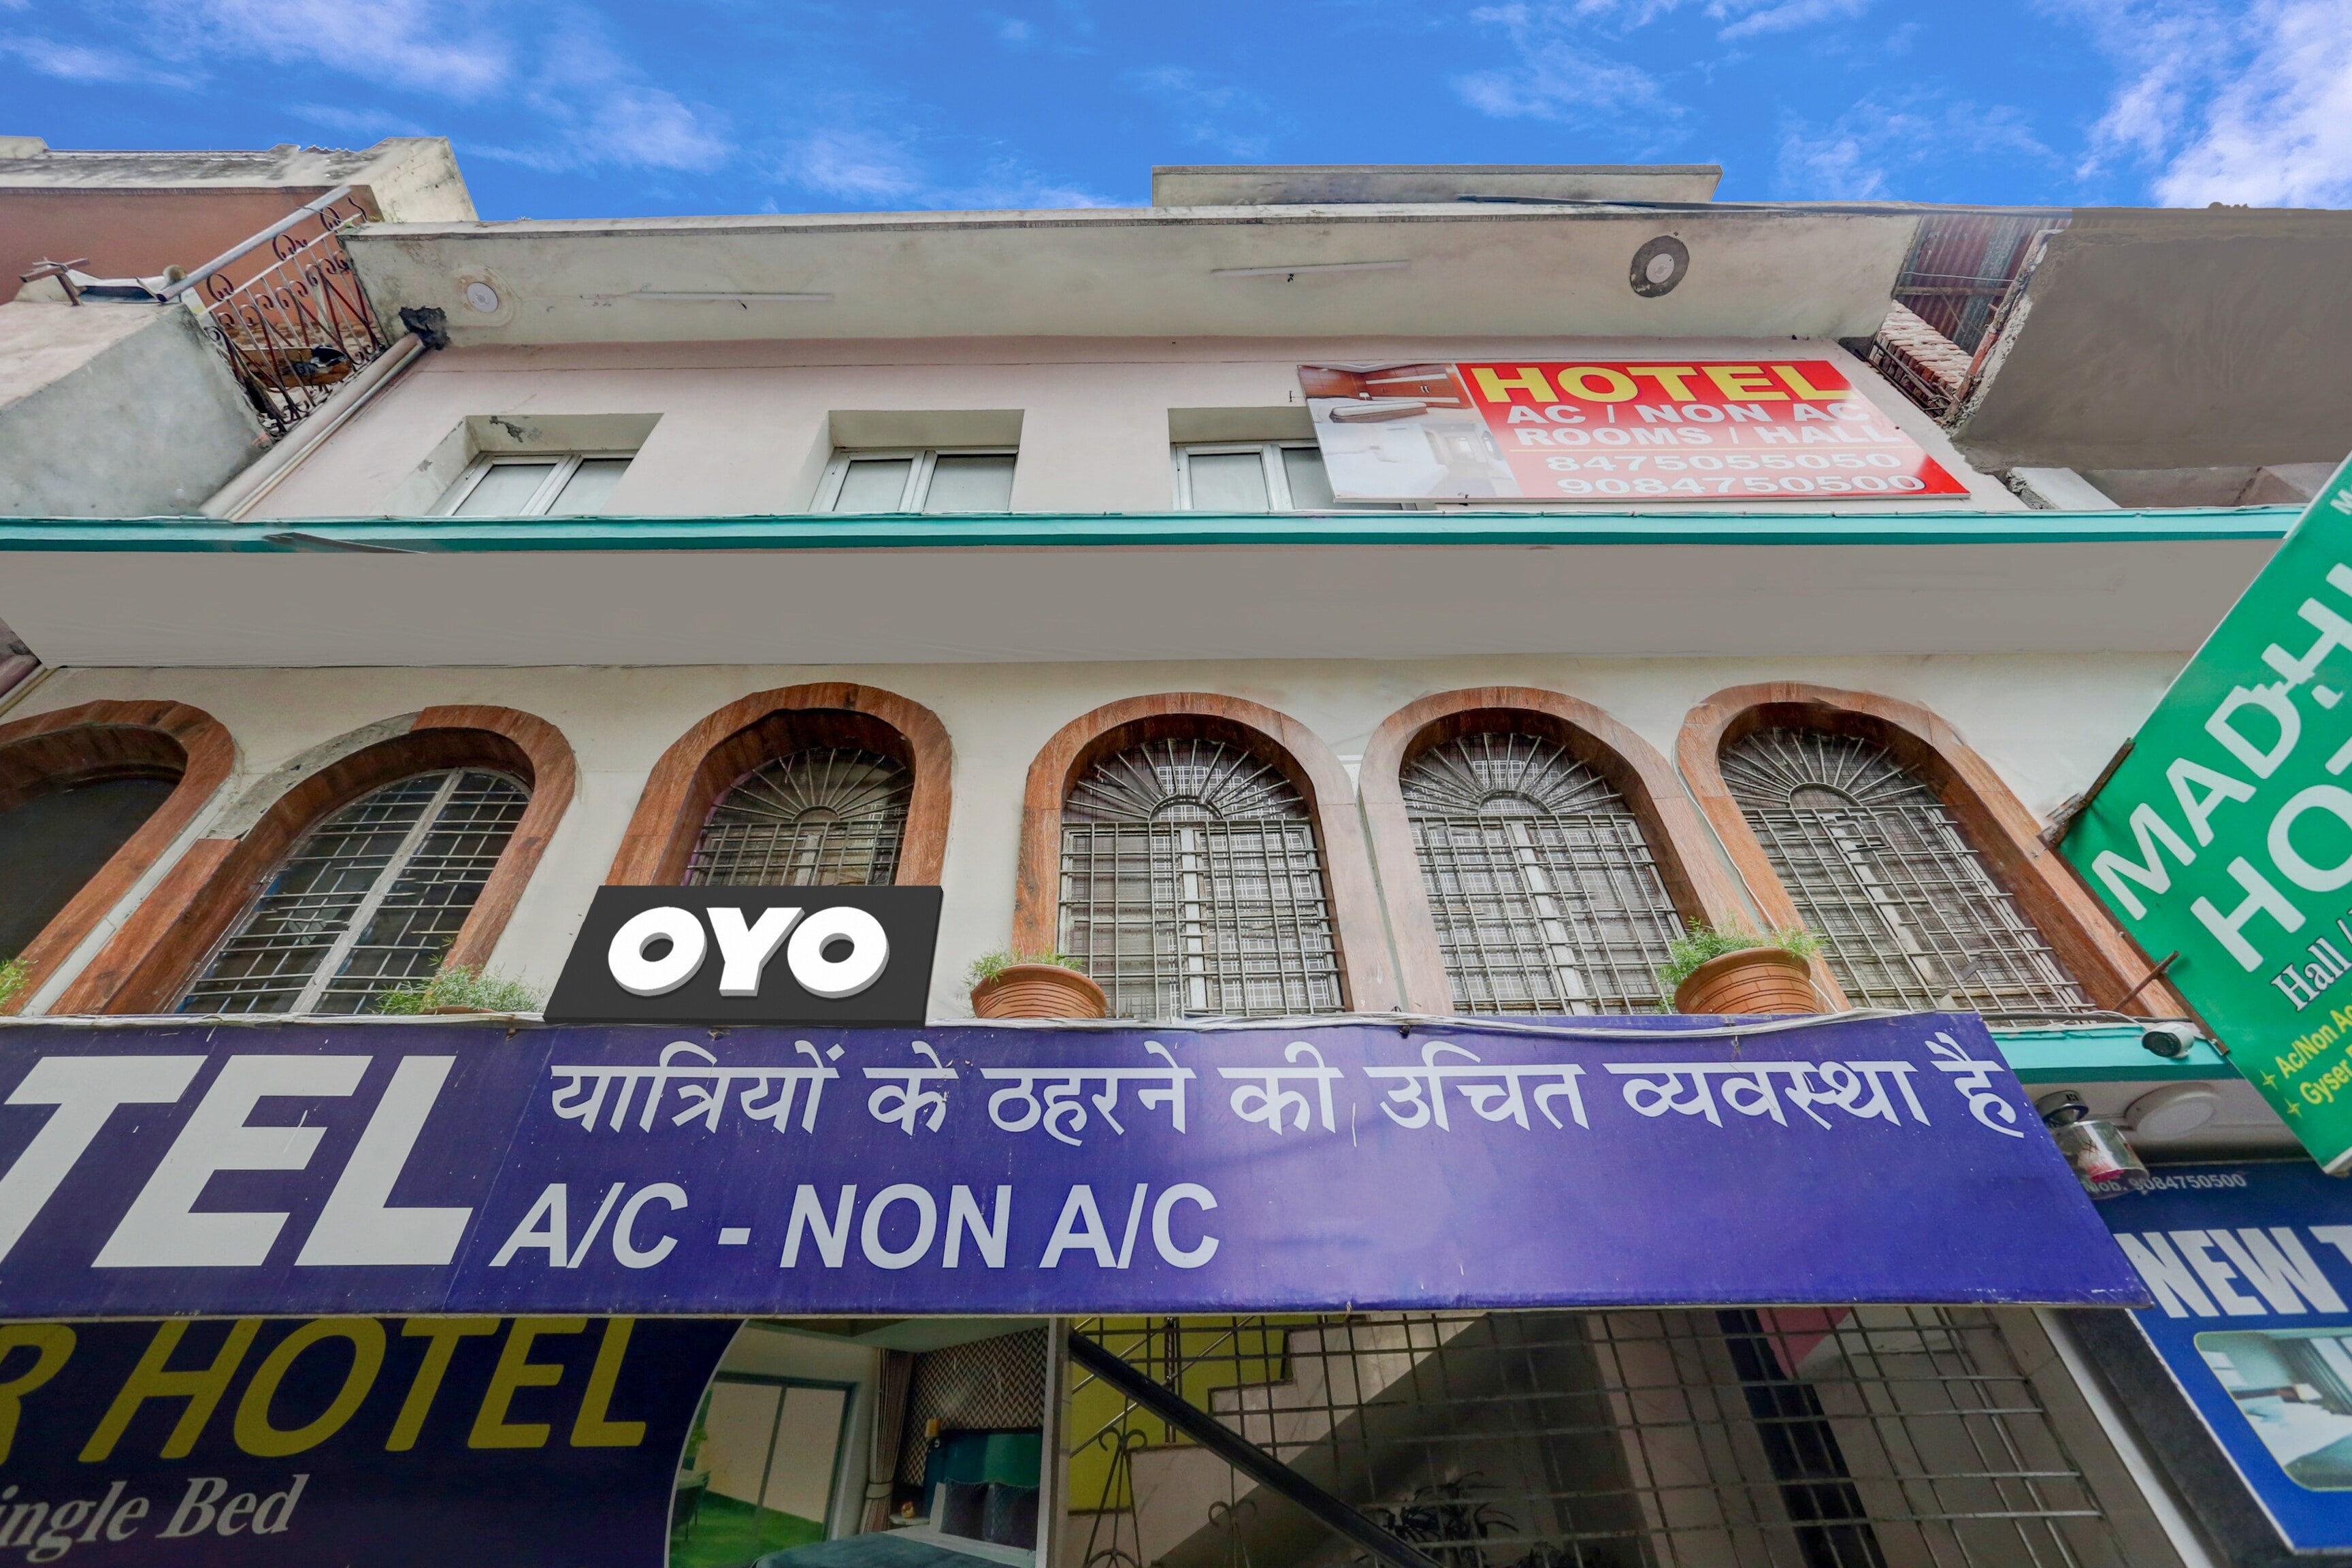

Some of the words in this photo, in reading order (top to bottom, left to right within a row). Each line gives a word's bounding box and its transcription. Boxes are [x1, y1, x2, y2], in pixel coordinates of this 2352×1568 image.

[1471, 365, 1861, 402] HOTEL
[1507, 404, 1586, 423] AC
[1634, 403, 1773, 423] NON
[1793, 402, 1871, 421] AC
[1514, 426, 1714, 446] ROOMS
[1753, 425, 1902, 444] HALL
[1546, 453, 1902, 471] 8475055050
[1556, 475, 1926, 494] 9084750500
[2091, 562, 2352, 921] MADH
[2190, 736, 2352, 973] HO
[608, 906, 890, 998] OYO
[2270, 936, 2352, 1013] Hall
[551, 1040, 845, 1134] यात्रियों
[862, 1041, 960, 1136] के
[979, 1040, 1198, 1146] ठहरने
[1218, 1041, 1344, 1136] की
[1362, 1039, 1590, 1132] उचित
[1602, 1060, 1931, 1130] व्यवस्था
[1925, 1032, 2025, 1138] है
[2275, 1024, 2339, 1079] Ac/Non
[2299, 1058, 2352, 1105] Gyser
[0, 1054, 474, 1268] TEL
[488, 1182, 688, 1269] A/C
[780, 1183, 1012, 1269] NON
[1039, 1182, 1220, 1269] A/C
[2112, 1227, 2349, 1318] NEW
[78, 1317, 646, 1462] HOTEL
[155, 1473, 310, 1539] Bed
